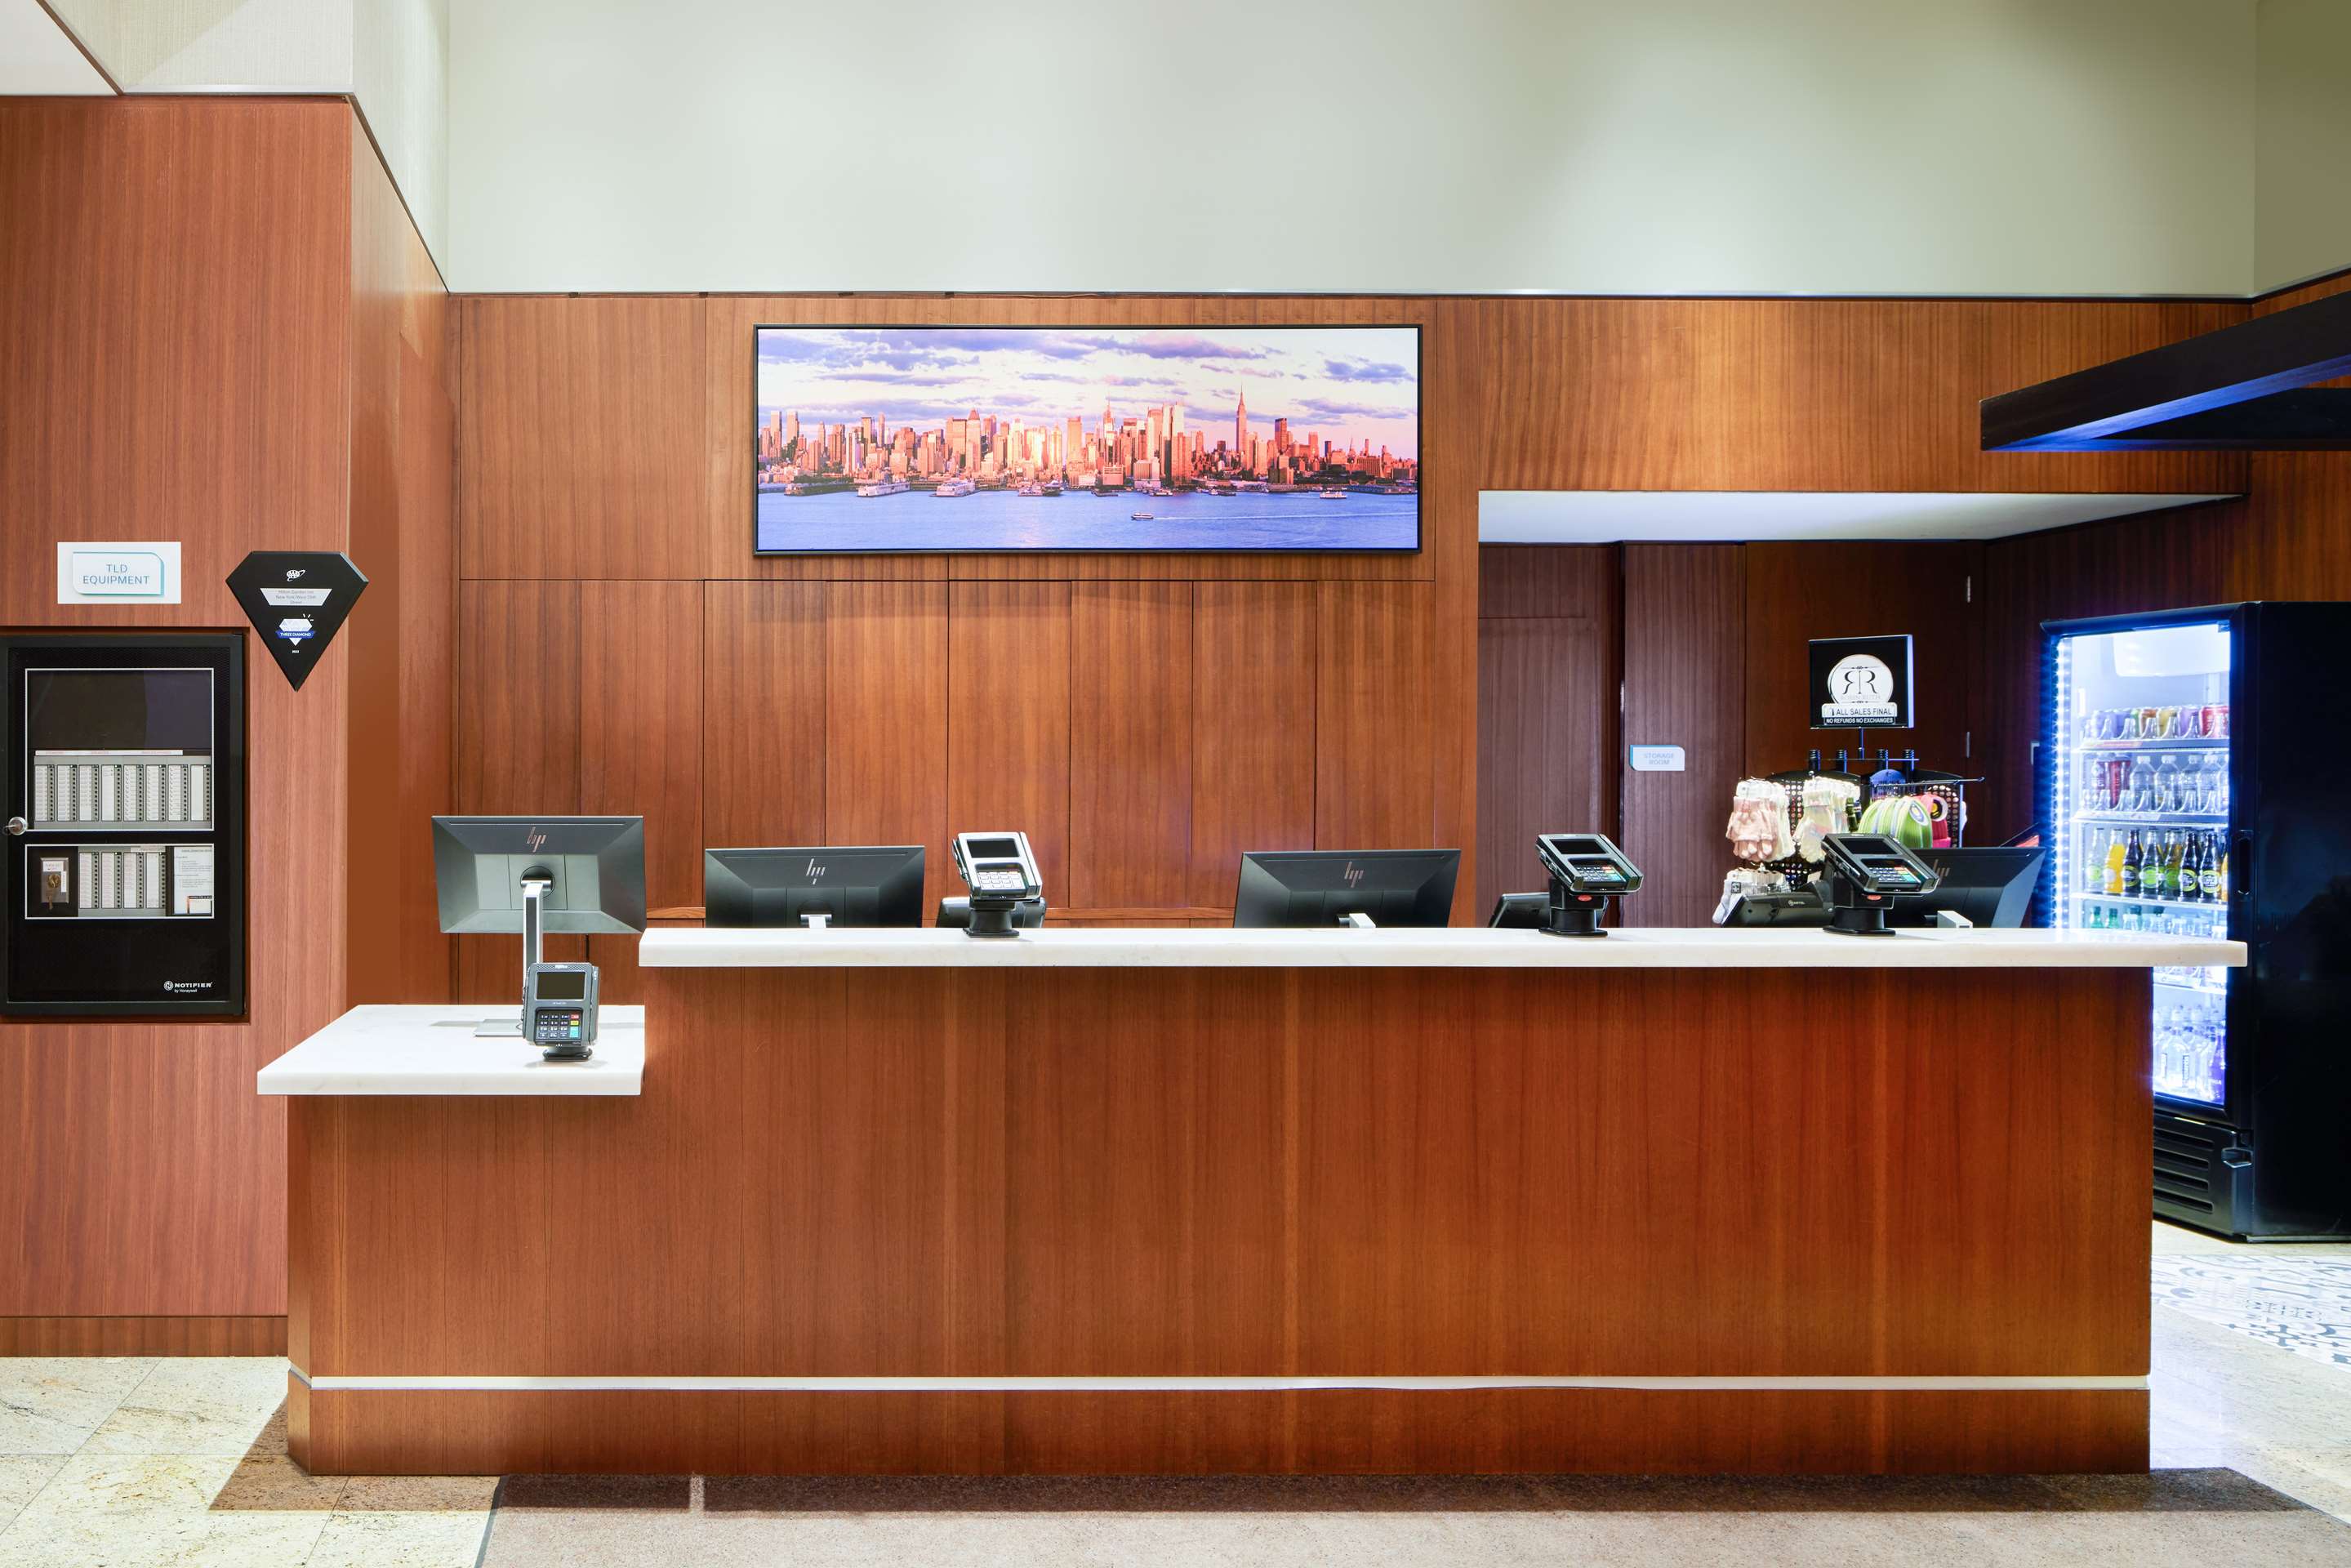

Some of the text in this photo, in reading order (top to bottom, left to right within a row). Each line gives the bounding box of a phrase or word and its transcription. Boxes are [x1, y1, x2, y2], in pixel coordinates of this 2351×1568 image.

[106, 564, 128, 572] TLD
[83, 576, 150, 584] EQUIPMENT
[1872, 707, 1892, 715] FINAL
